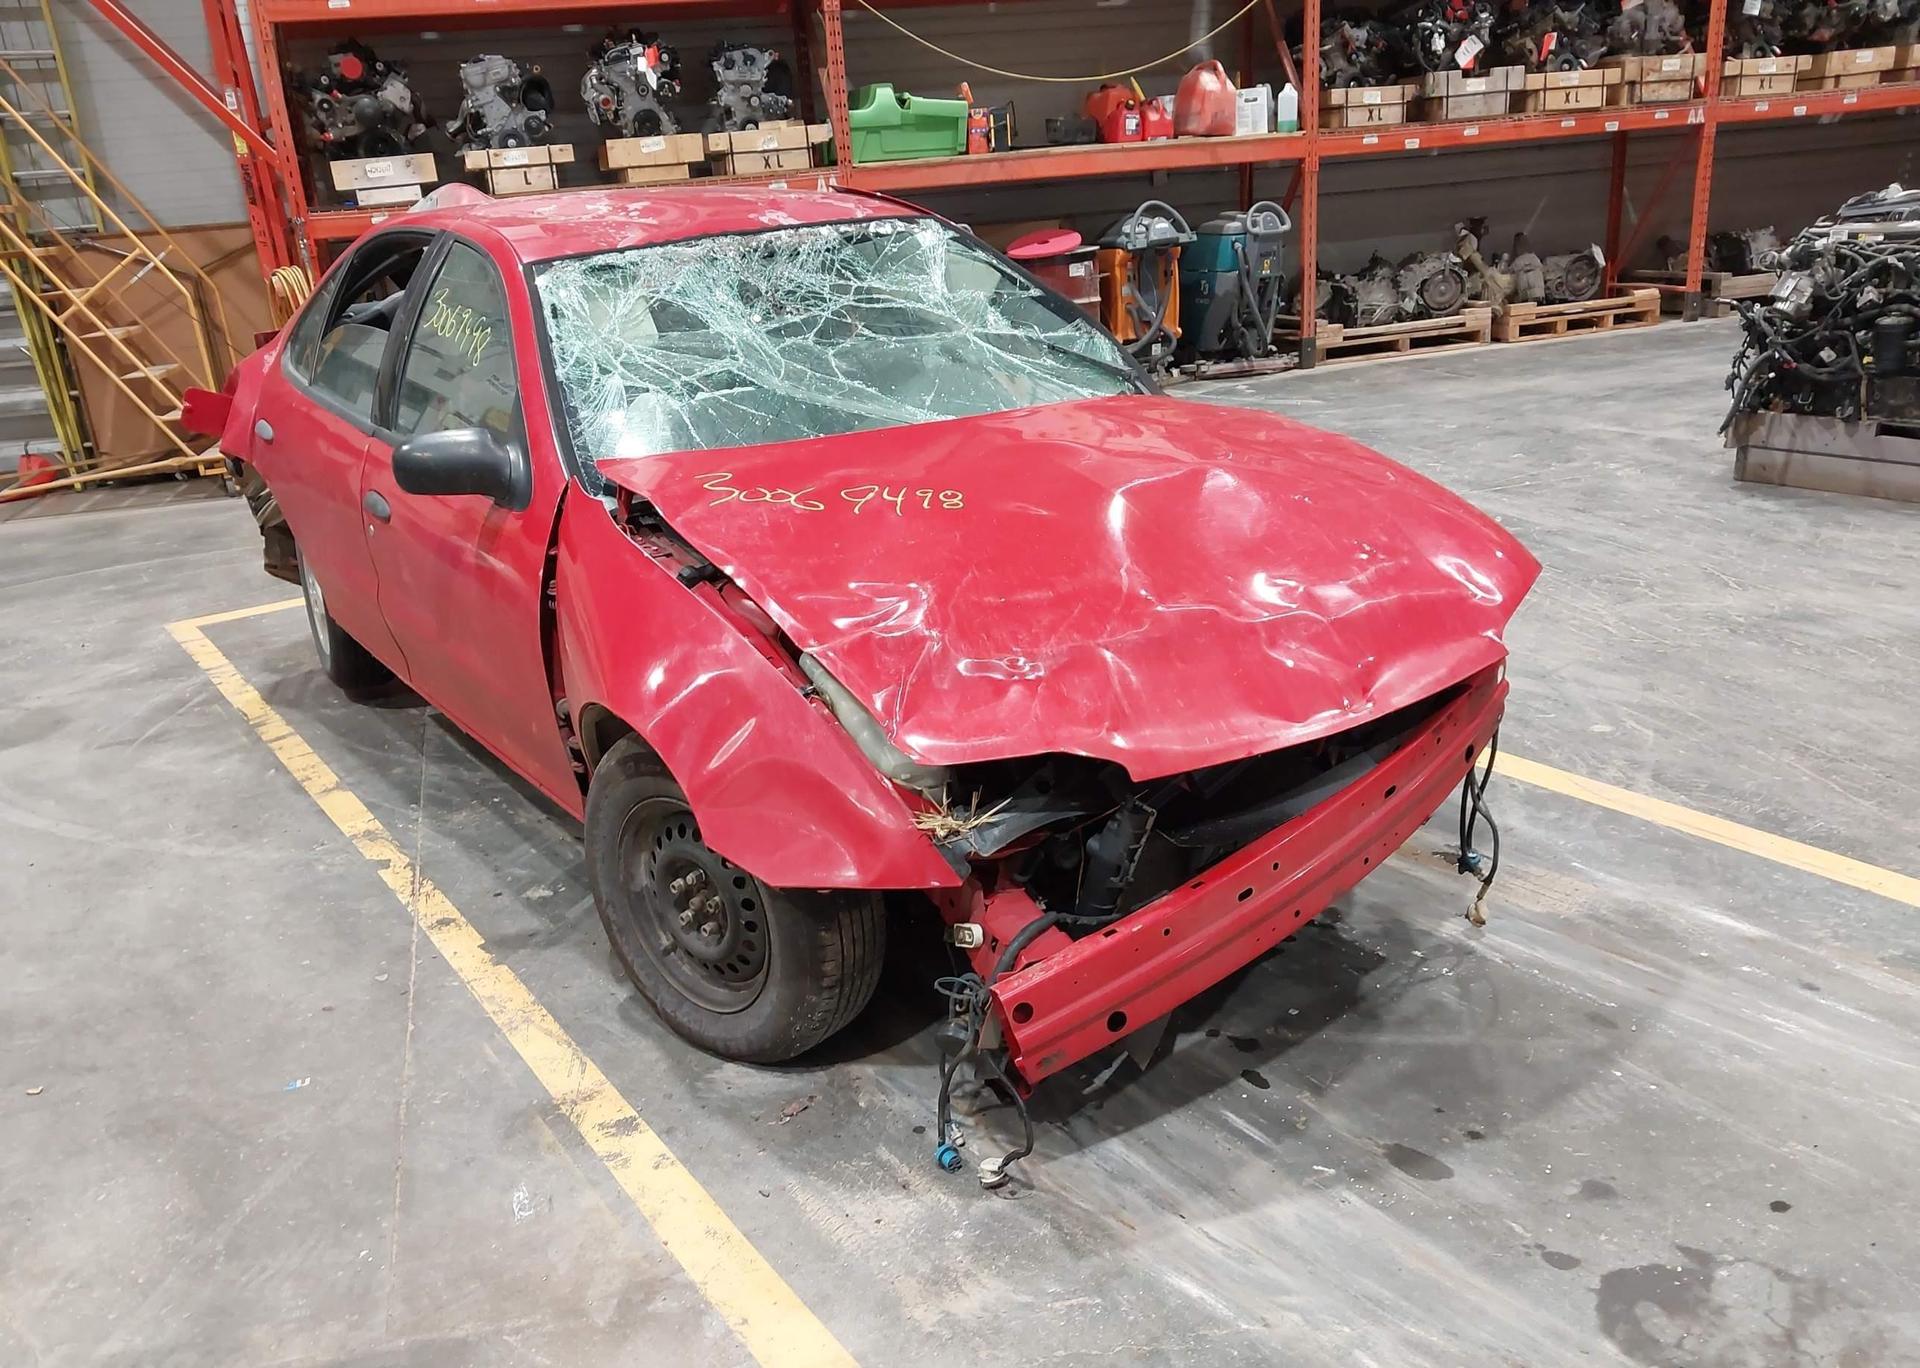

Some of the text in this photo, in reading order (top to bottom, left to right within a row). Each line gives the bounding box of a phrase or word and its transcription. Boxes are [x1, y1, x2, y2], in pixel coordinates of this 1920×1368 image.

[523, 170, 532, 185] L
[694, 472, 965, 516] 3006 9498
